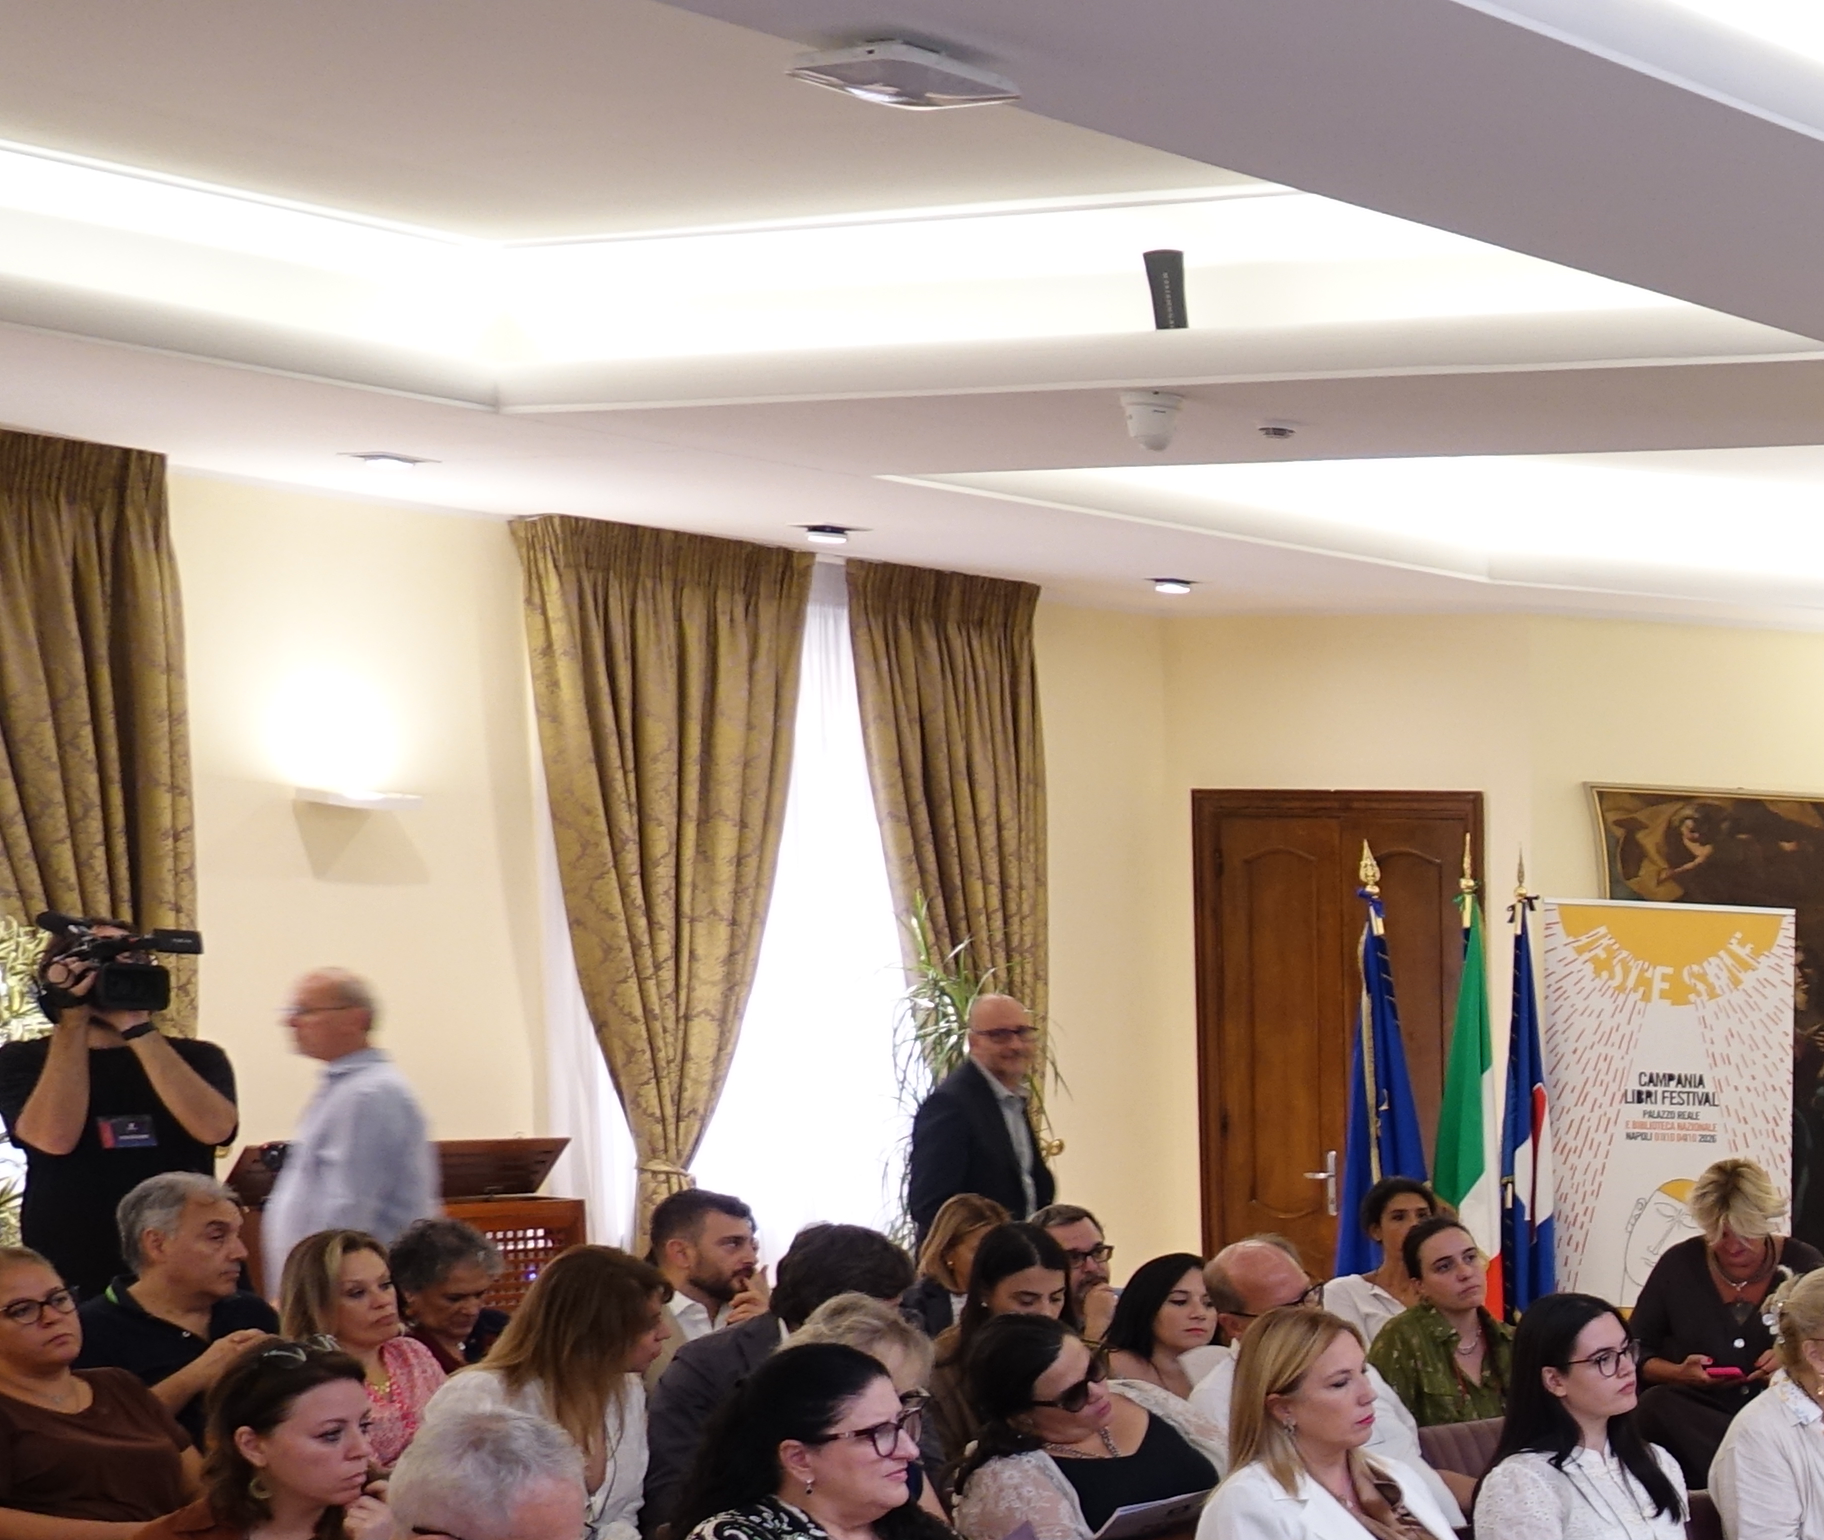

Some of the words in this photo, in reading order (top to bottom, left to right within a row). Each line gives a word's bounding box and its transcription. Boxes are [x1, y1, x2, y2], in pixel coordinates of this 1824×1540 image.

[1638, 1071, 1705, 1088] CAMPANIA
[1624, 1089, 1658, 1105] LIBRI
[1661, 1090, 1720, 1107] FESTIVAL
[1642, 1109, 1675, 1119] PALAZZO
[1677, 1110, 1701, 1121] REALE
[1625, 1131, 1652, 1141] NAPOLI
